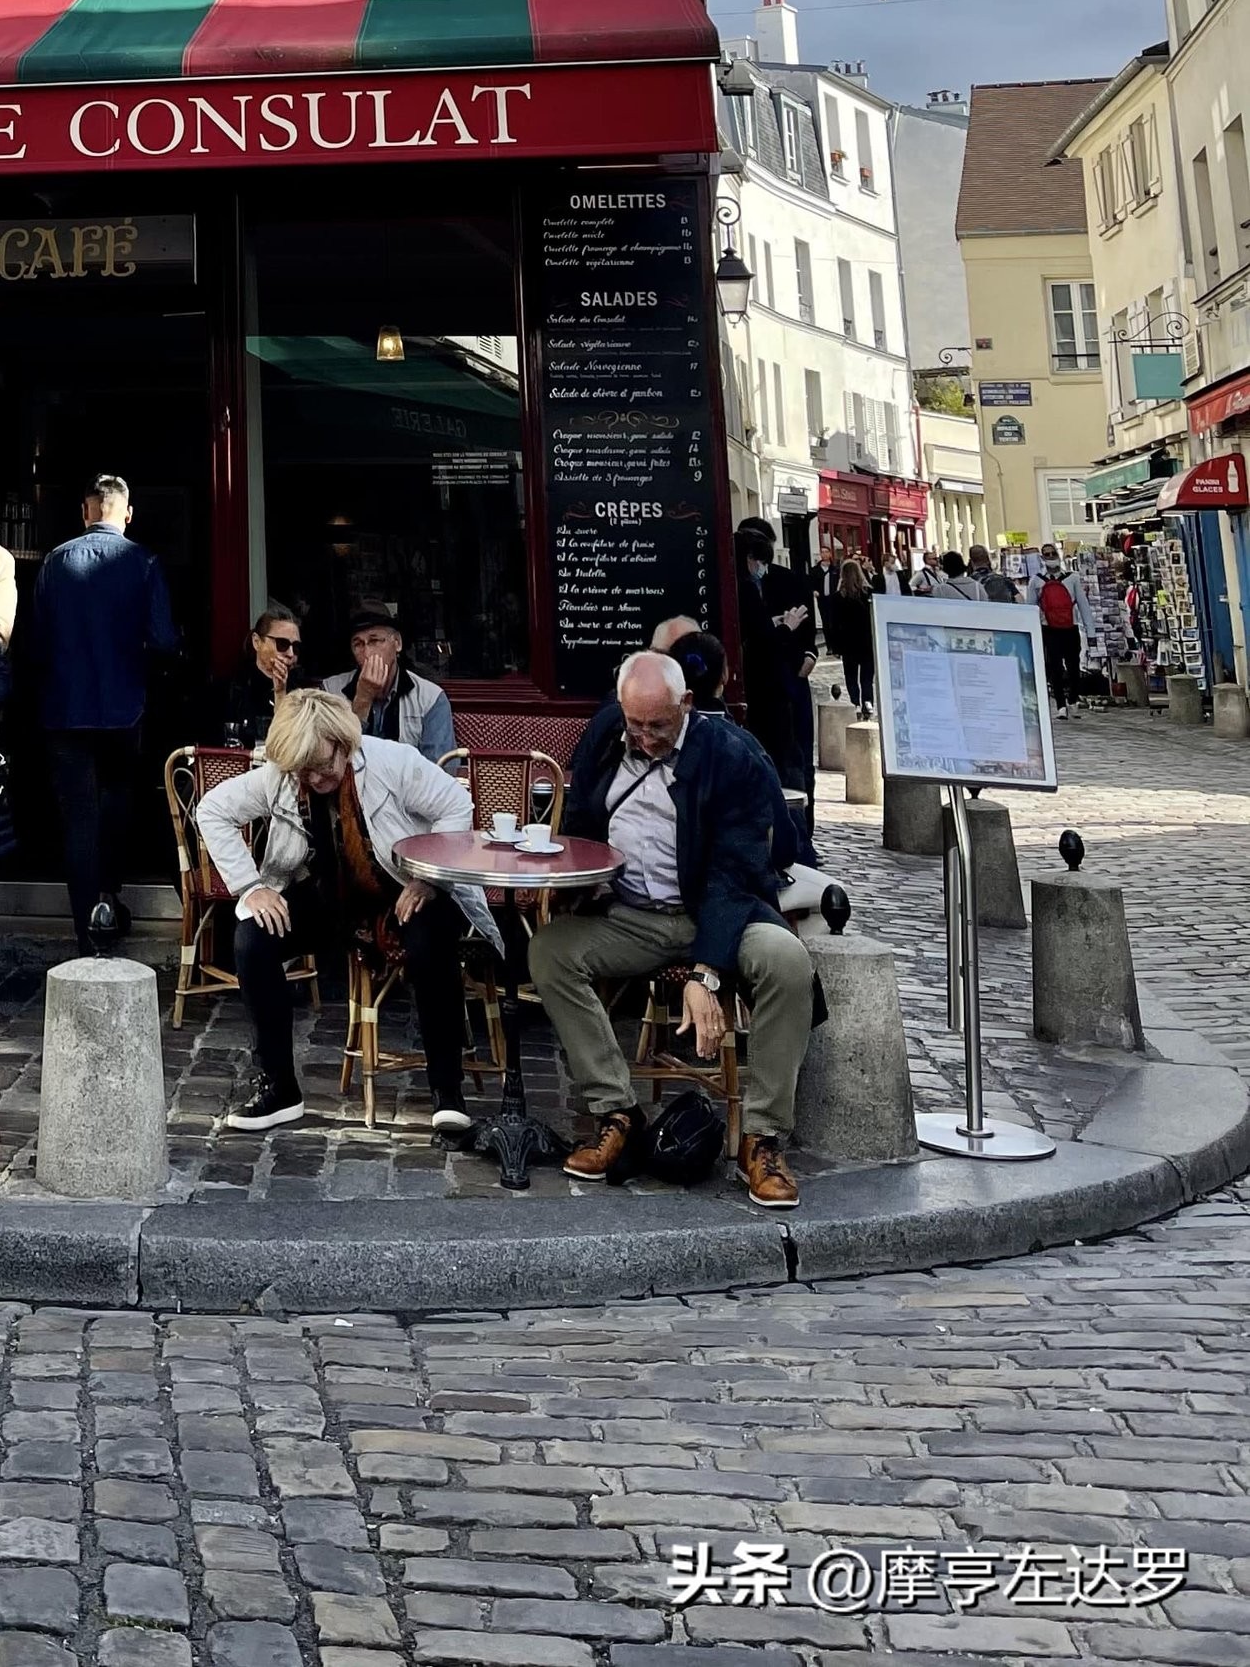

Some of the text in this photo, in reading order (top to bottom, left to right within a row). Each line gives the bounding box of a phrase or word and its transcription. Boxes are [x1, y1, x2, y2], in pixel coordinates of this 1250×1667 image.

[67, 81, 532, 159] CONSULAT
[569, 193, 667, 209] OMELETTES
[580, 291, 659, 307] SALADES
[693, 469, 703, 482] 9
[594, 499, 664, 518] CRÊPES
